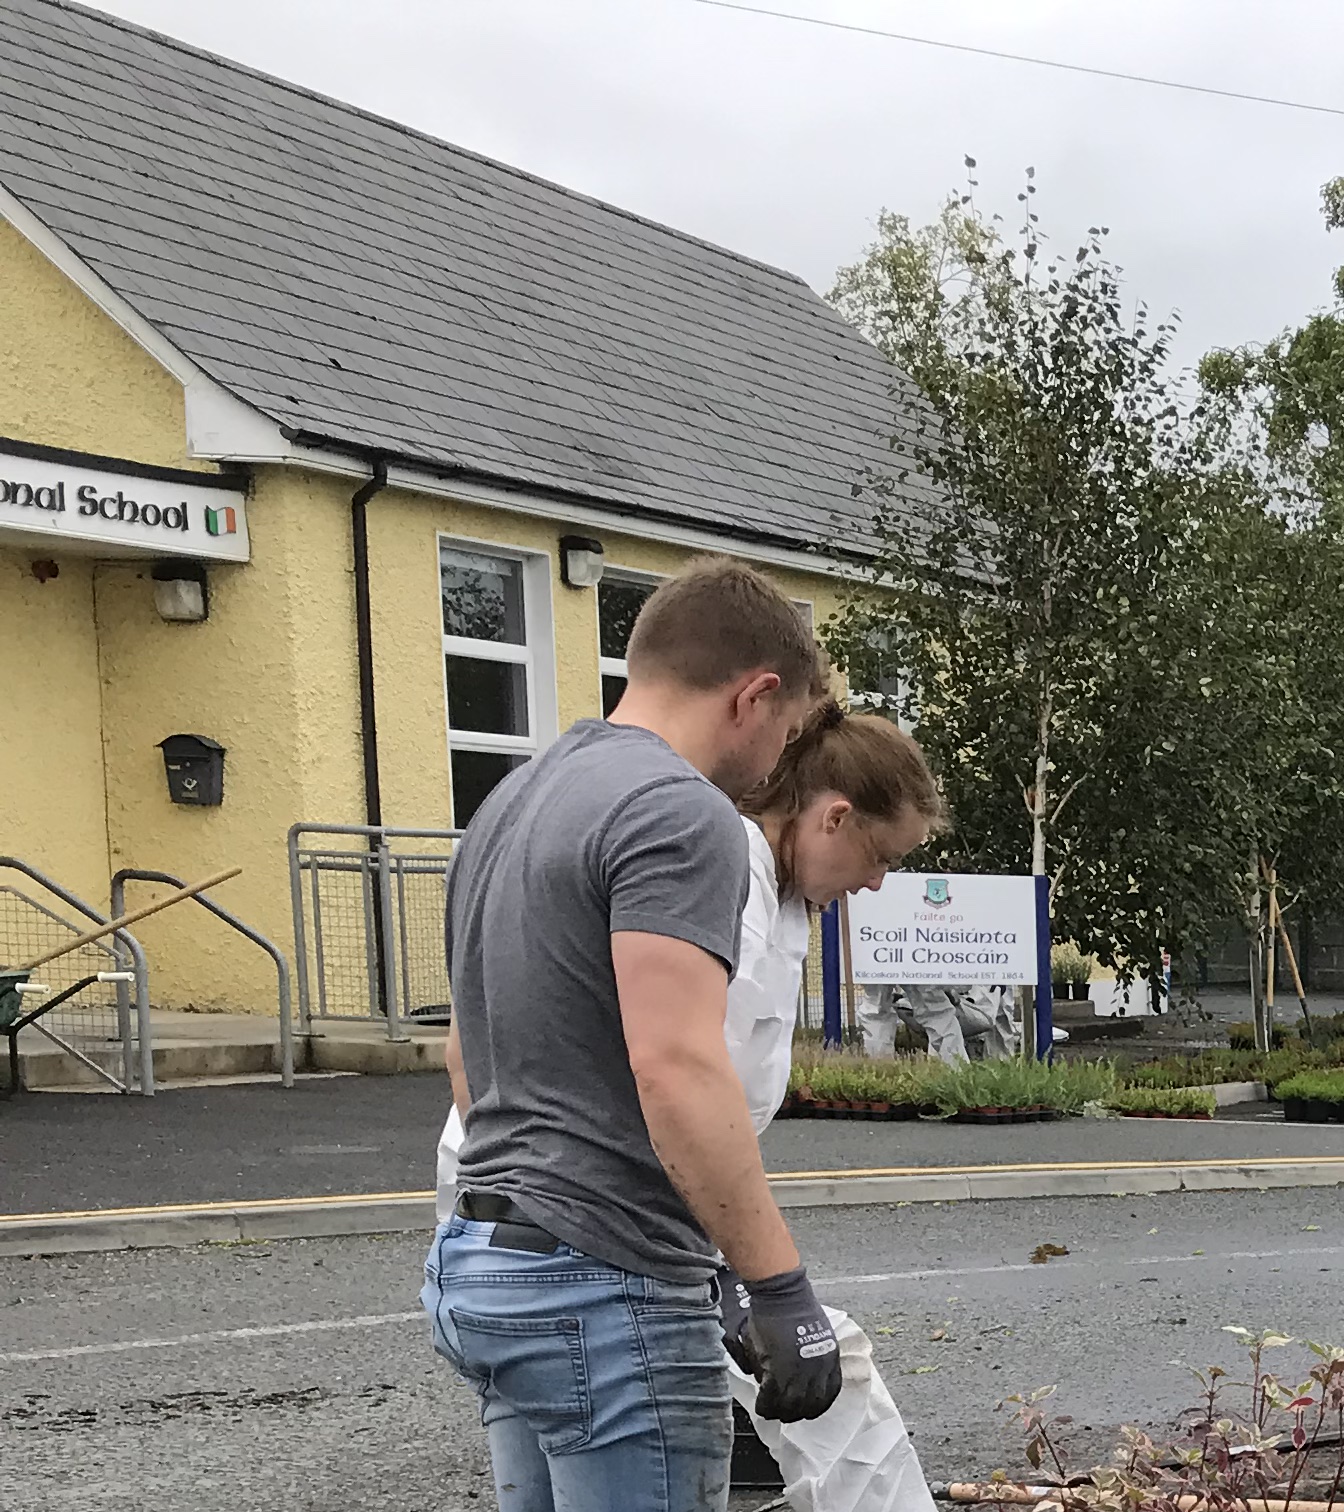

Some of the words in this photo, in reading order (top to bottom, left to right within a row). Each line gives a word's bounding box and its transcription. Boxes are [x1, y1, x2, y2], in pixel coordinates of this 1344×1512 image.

[77, 485, 190, 532] School
[949, 914, 964, 924] go
[859, 926, 908, 943] Scoil
[915, 927, 1017, 944] Náisiúnta
[873, 947, 903, 964] Cill
[911, 947, 1009, 965] Choscáin
[854, 970, 900, 979] Kilcoskan
[901, 970, 943, 979] National
[947, 971, 979, 980] School
